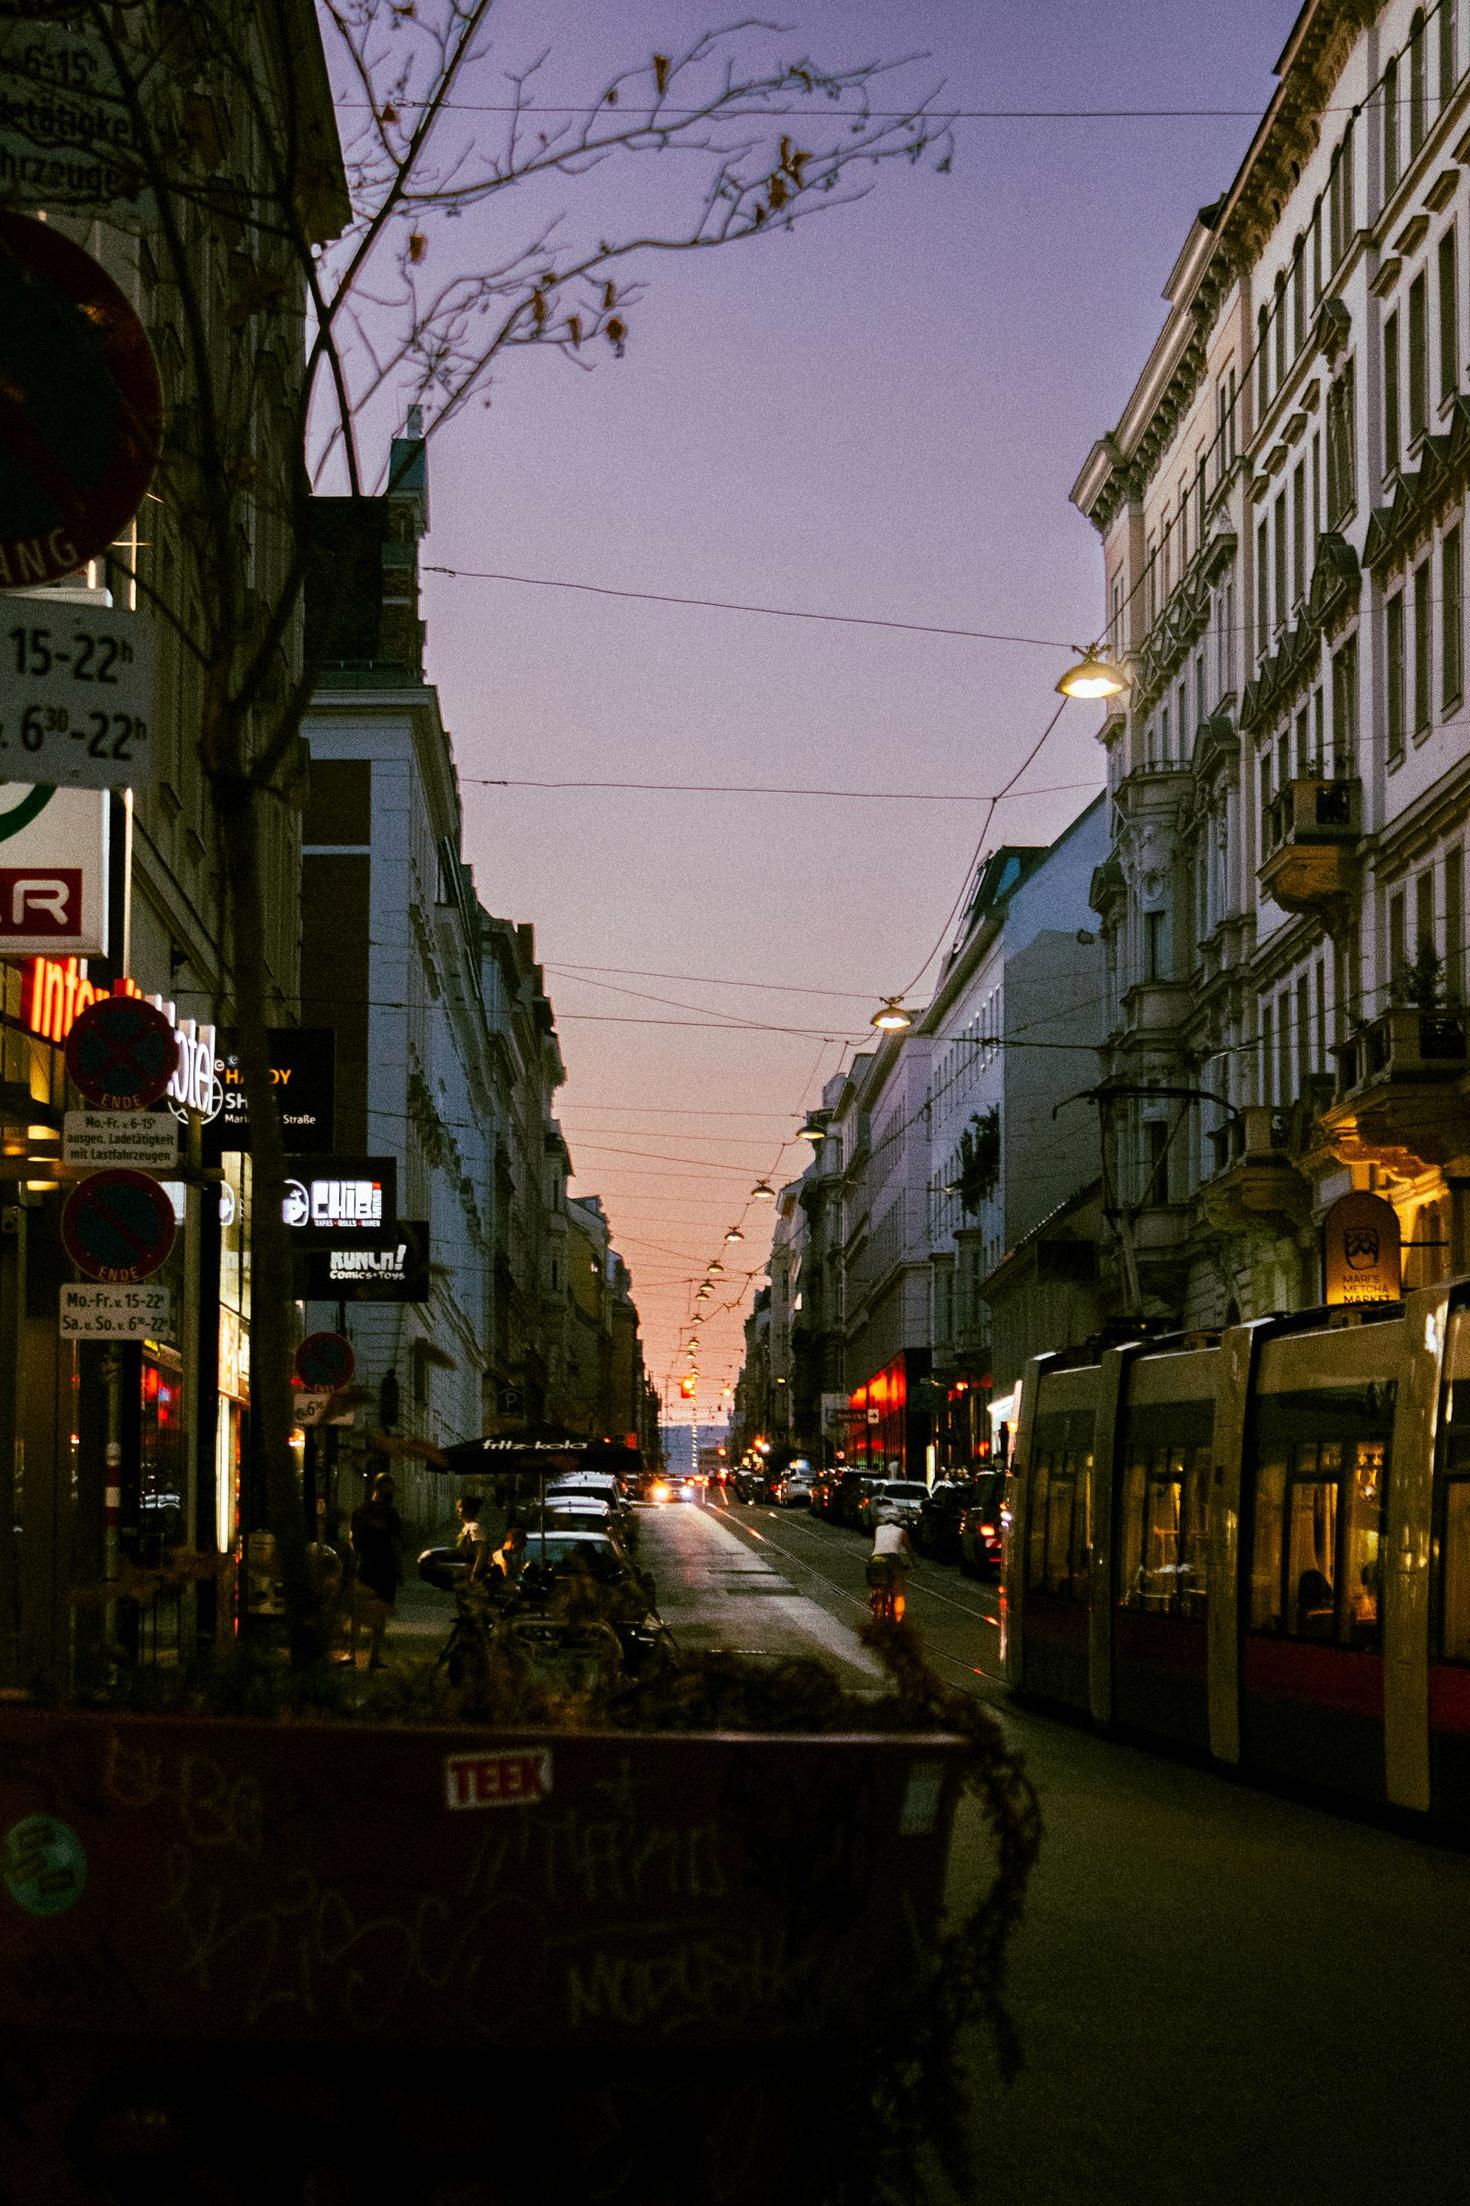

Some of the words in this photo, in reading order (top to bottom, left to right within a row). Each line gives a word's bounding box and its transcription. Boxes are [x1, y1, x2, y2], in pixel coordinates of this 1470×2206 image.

[0, 879, 70, 925] R
[225, 1067, 292, 1085] HDY
[100, 1093, 141, 1110] ENDE
[283, 1114, 317, 1125] Straße
[109, 1133, 174, 1147] Ladetätigkeit
[70, 1147, 88, 1160] mit
[91, 1148, 171, 1163] Lastfahrzeugen
[98, 1266, 140, 1281] ENDE
[482, 1440, 589, 1450] fritz-kola
